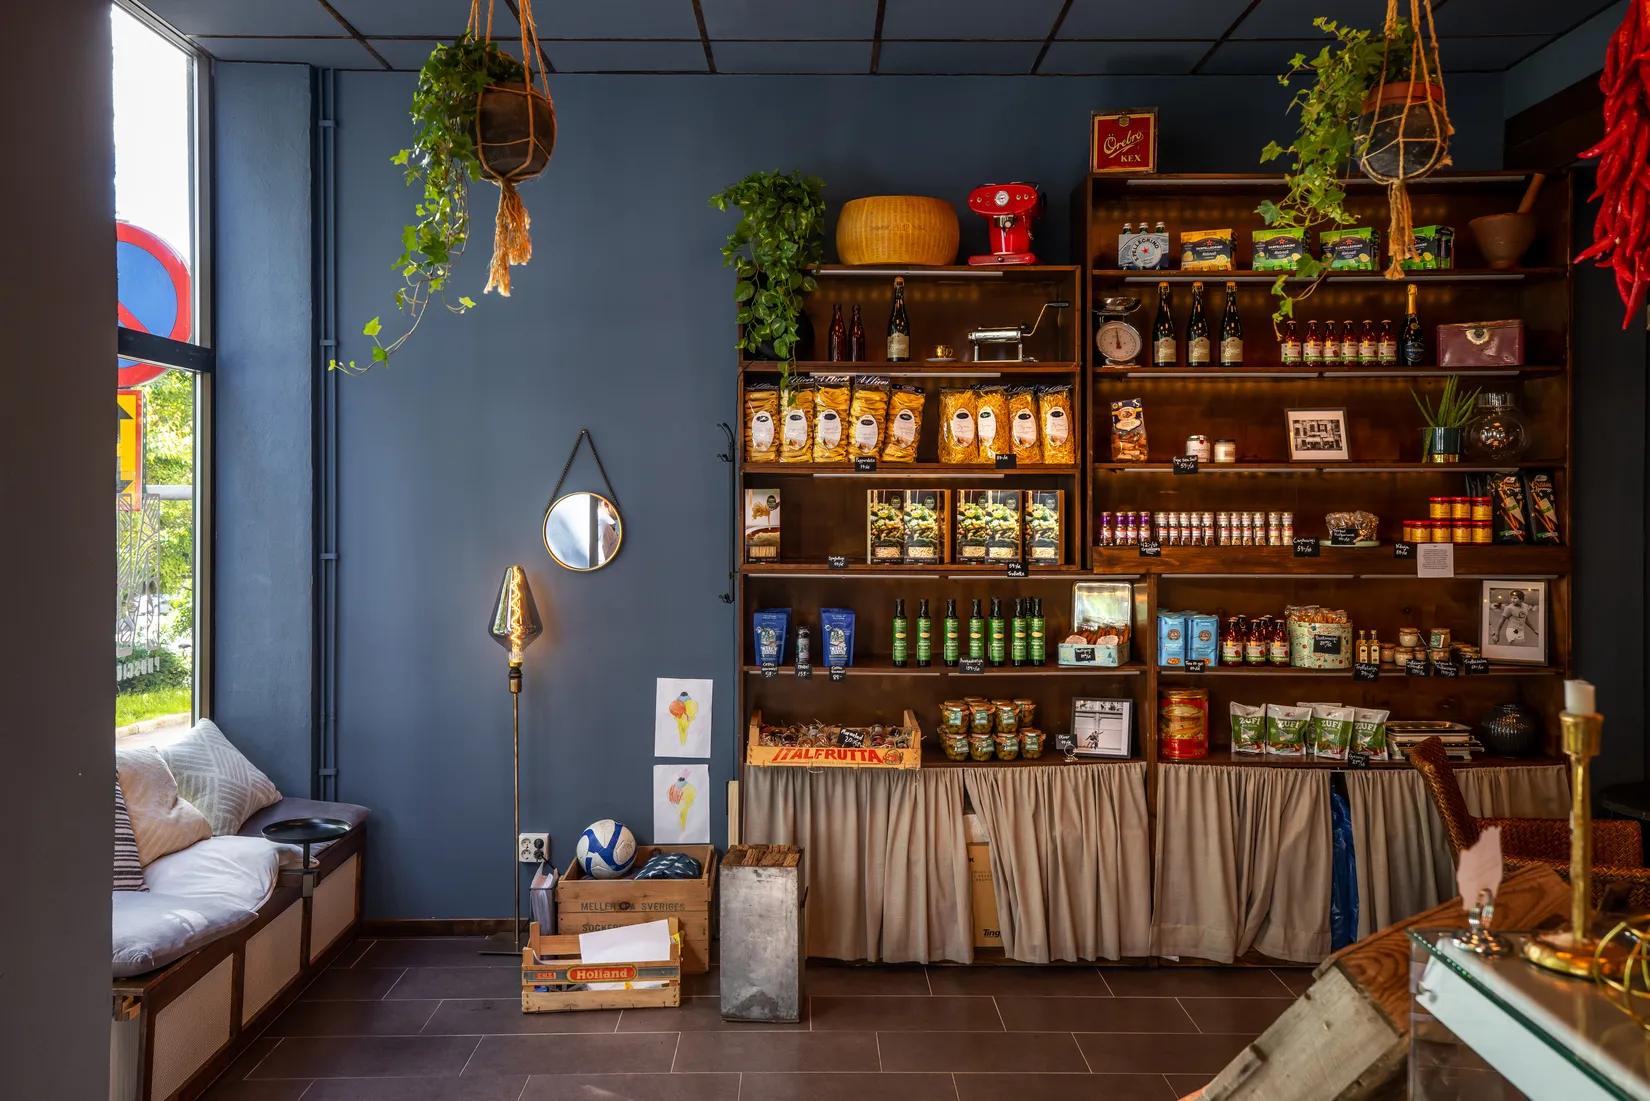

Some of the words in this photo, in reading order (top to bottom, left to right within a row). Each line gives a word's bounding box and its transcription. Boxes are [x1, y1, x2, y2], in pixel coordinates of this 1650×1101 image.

[1104, 130, 1144, 154] Örebro
[1120, 154, 1141, 162] KEX
[772, 748, 884, 763] ITALFRUTTA
[576, 968, 628, 979] Holland
